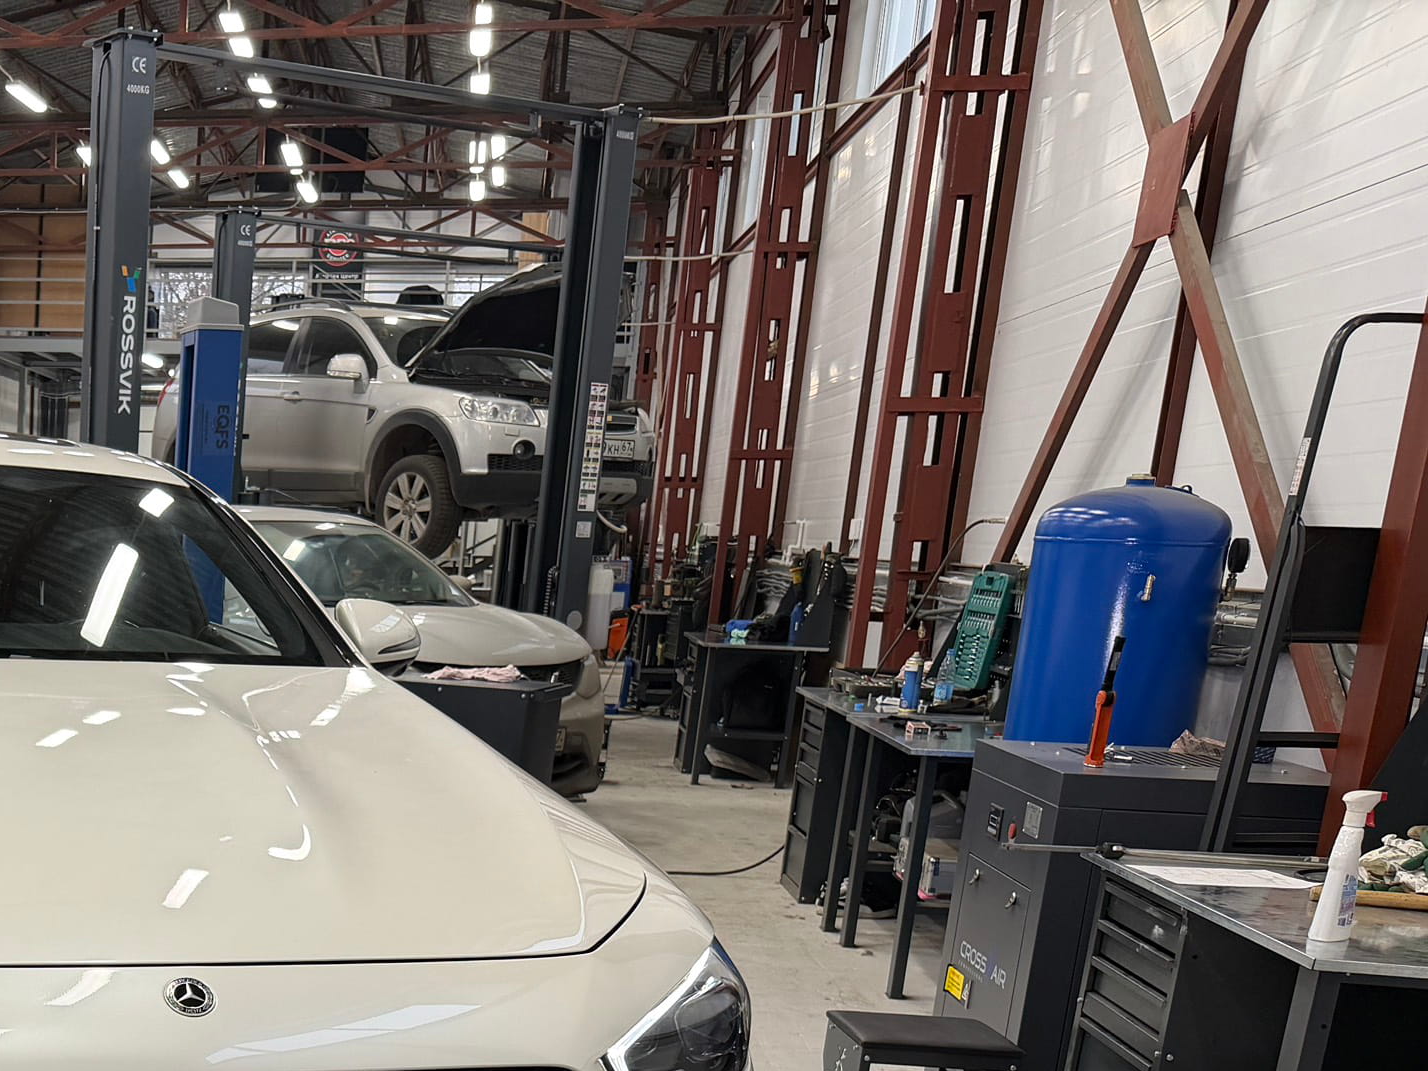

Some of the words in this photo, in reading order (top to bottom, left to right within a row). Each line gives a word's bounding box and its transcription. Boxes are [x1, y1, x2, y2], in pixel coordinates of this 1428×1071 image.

[132, 56, 147, 74] CE
[117, 295, 137, 416] ROSSVIK
[215, 404, 230, 449] EQFS
[960, 940, 988, 974] CROSS
[990, 964, 1007, 990] AIR
